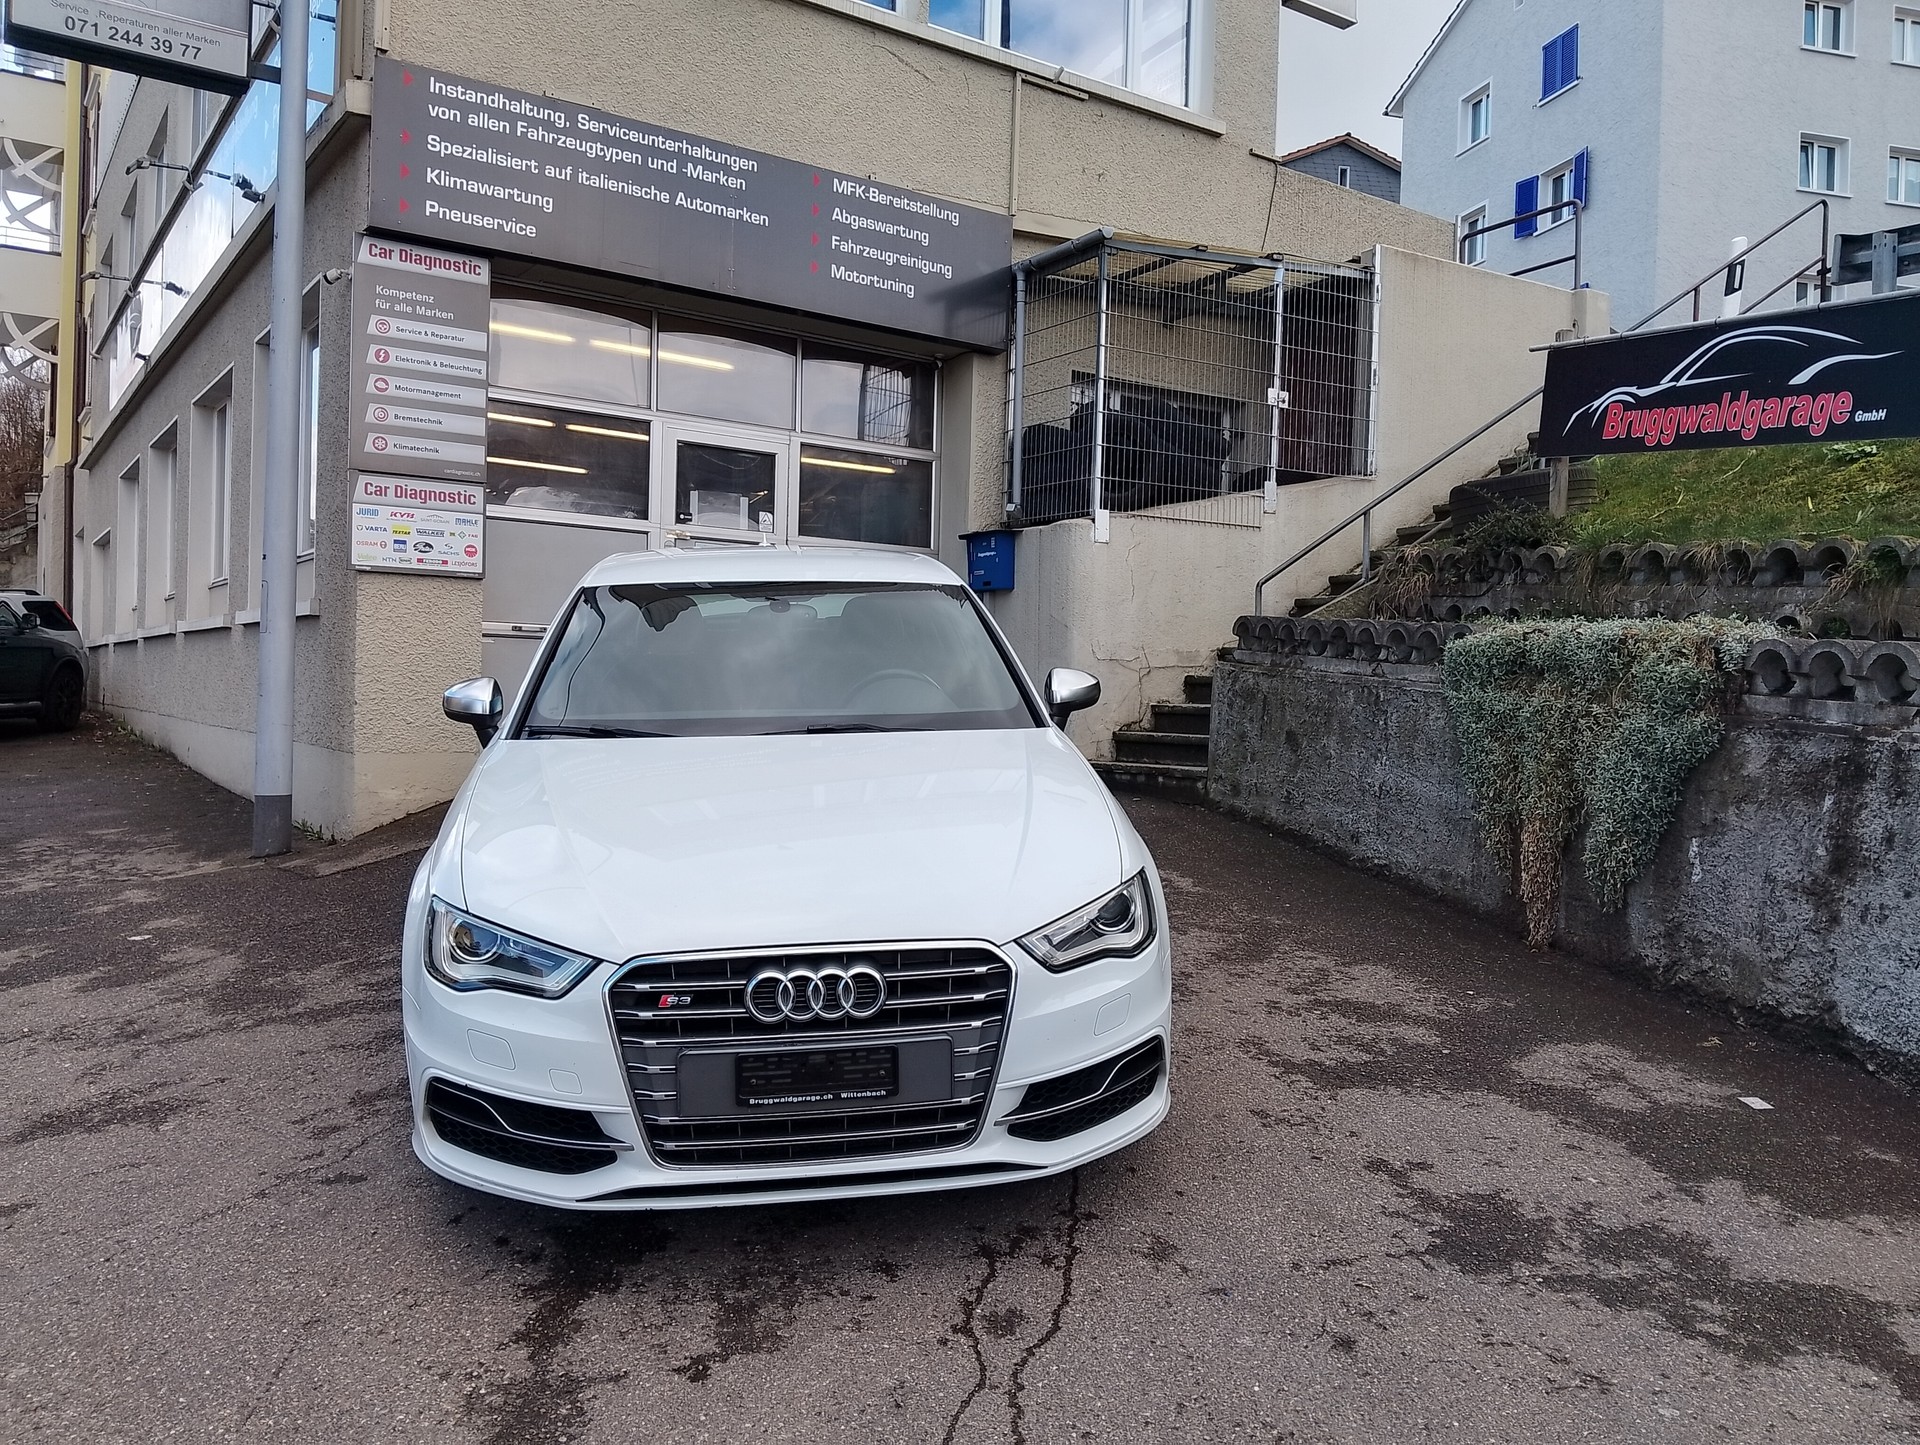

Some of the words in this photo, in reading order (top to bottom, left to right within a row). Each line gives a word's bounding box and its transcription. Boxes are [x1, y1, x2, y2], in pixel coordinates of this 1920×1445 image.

[51, 0, 89, 15] Service
[162, 26, 184, 38] aller
[186, 31, 221, 47] Marken
[64, 16, 99, 37] 071
[108, 26, 144, 47] 244
[150, 36, 173, 53] 39
[180, 43, 202, 60] 77
[429, 76, 570, 128] Instandhaltung,
[577, 113, 758, 172] Serviceunterhaltungen
[428, 104, 461, 123] von
[467, 112, 510, 134] allen
[516, 121, 642, 163] Fahrzeugtypen
[648, 156, 677, 174] und
[682, 162, 746, 191] -Marken
[426, 167, 554, 213] Klimawartung
[427, 134, 539, 174] Spezialisiert
[545, 164, 573, 182] auf
[578, 168, 670, 204] italienische
[675, 191, 769, 227] Automarken
[425, 200, 537, 237] Pneuservice
[833, 178, 960, 227] MFK-Bereitstellung
[832, 207, 929, 246] Abgaswartung
[368, 243, 395, 261] Car
[399, 248, 482, 277] Diagnostic
[831, 235, 953, 279] Fahrzeugreinigung
[376, 284, 435, 304] Kompetenz
[831, 264, 915, 299] Motortuning
[375, 298, 391, 310] für
[394, 303, 413, 314] alle
[416, 305, 454, 320] Marken
[395, 325, 422, 336] Service
[423, 330, 429, 338] &
[431, 331, 465, 343] Reparatur
[395, 355, 431, 367] Elektronik
[440, 361, 483, 375] Beleuchtung
[394, 384, 462, 400] Motormanagement
[394, 413, 443, 426] Bremstechnik
[1602, 390, 1852, 446] Bruggwaldgarage
[1855, 408, 1887, 423] GmbH
[393, 442, 440, 454] Klimatechnik
[364, 482, 390, 497] Car
[394, 484, 477, 505] Diagnostic
[356, 508, 379, 517] JURID
[364, 525, 388, 533] VARTA
[666, 996, 691, 1005] S3
